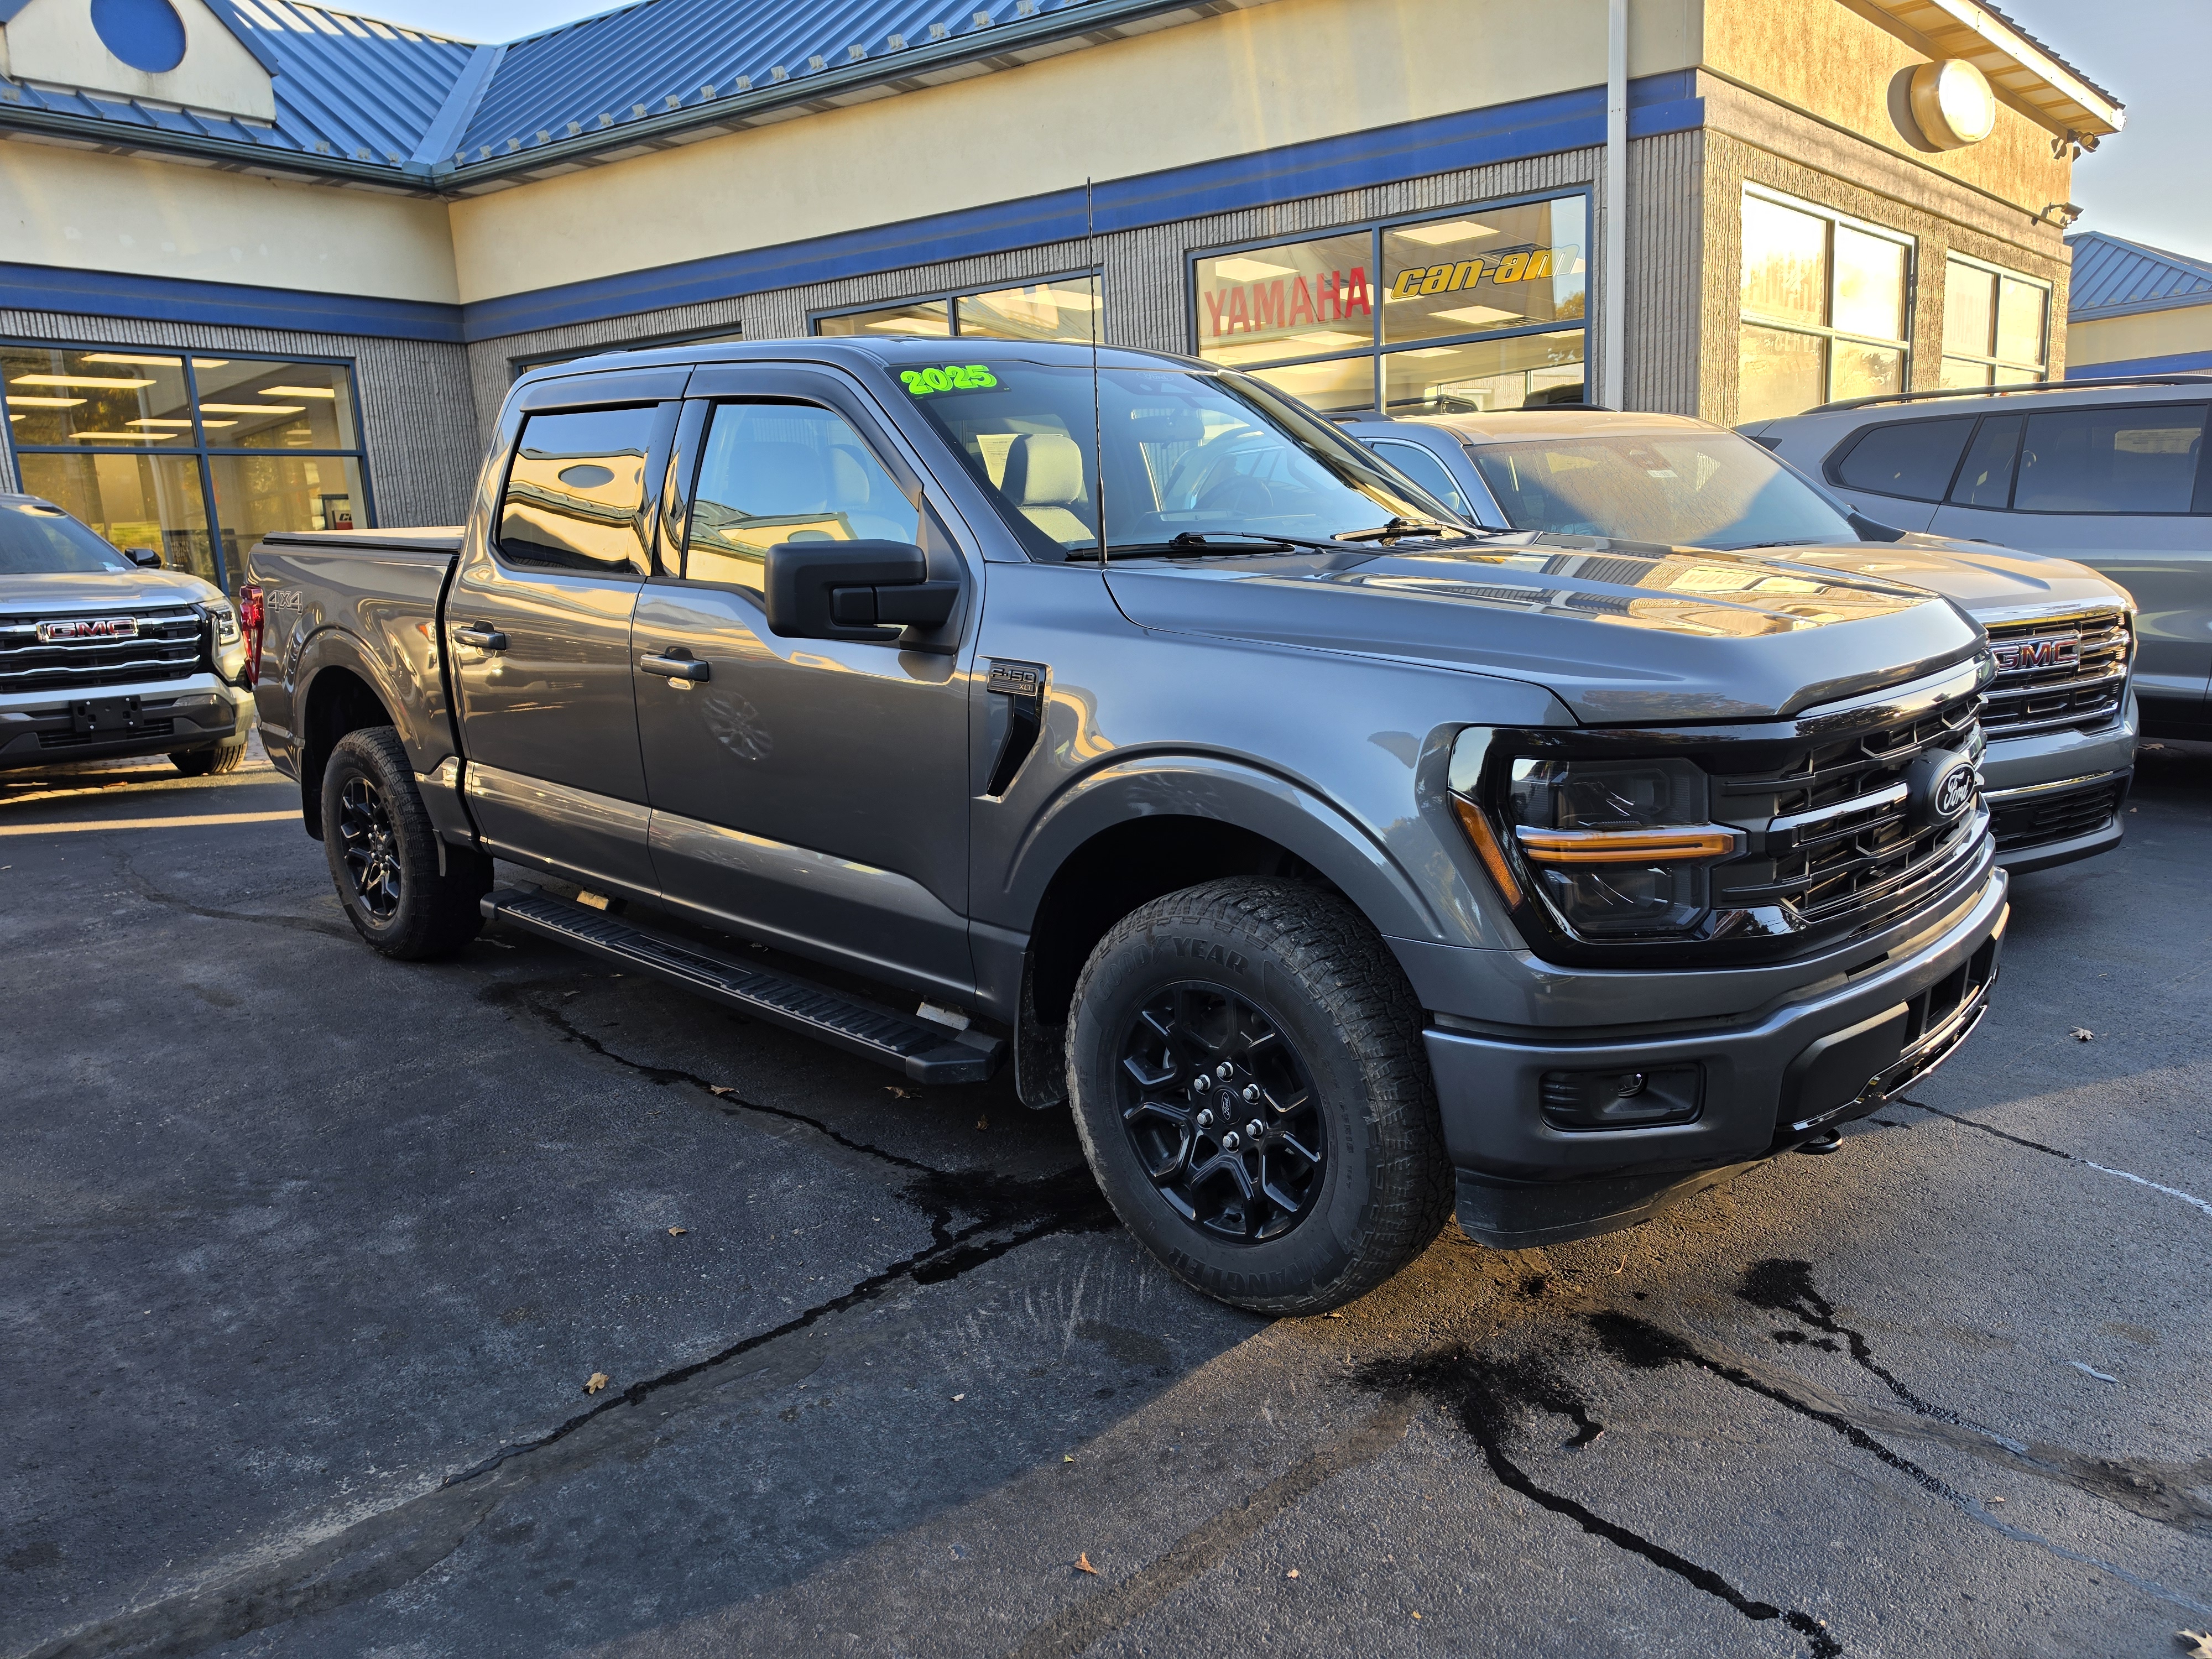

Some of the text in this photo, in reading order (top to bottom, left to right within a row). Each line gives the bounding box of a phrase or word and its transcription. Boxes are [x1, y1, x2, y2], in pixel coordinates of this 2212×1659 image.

[1390, 244, 1580, 299] can-am
[1204, 267, 1371, 337] YAMAHA
[900, 365, 997, 394] 2025
[46, 619, 134, 639] GMC
[1991, 639, 2078, 670] GMC
[990, 666, 1036, 684] F-150
[1944, 771, 1970, 810] Ford
[1168, 1243, 1333, 1295] WRANGLER
